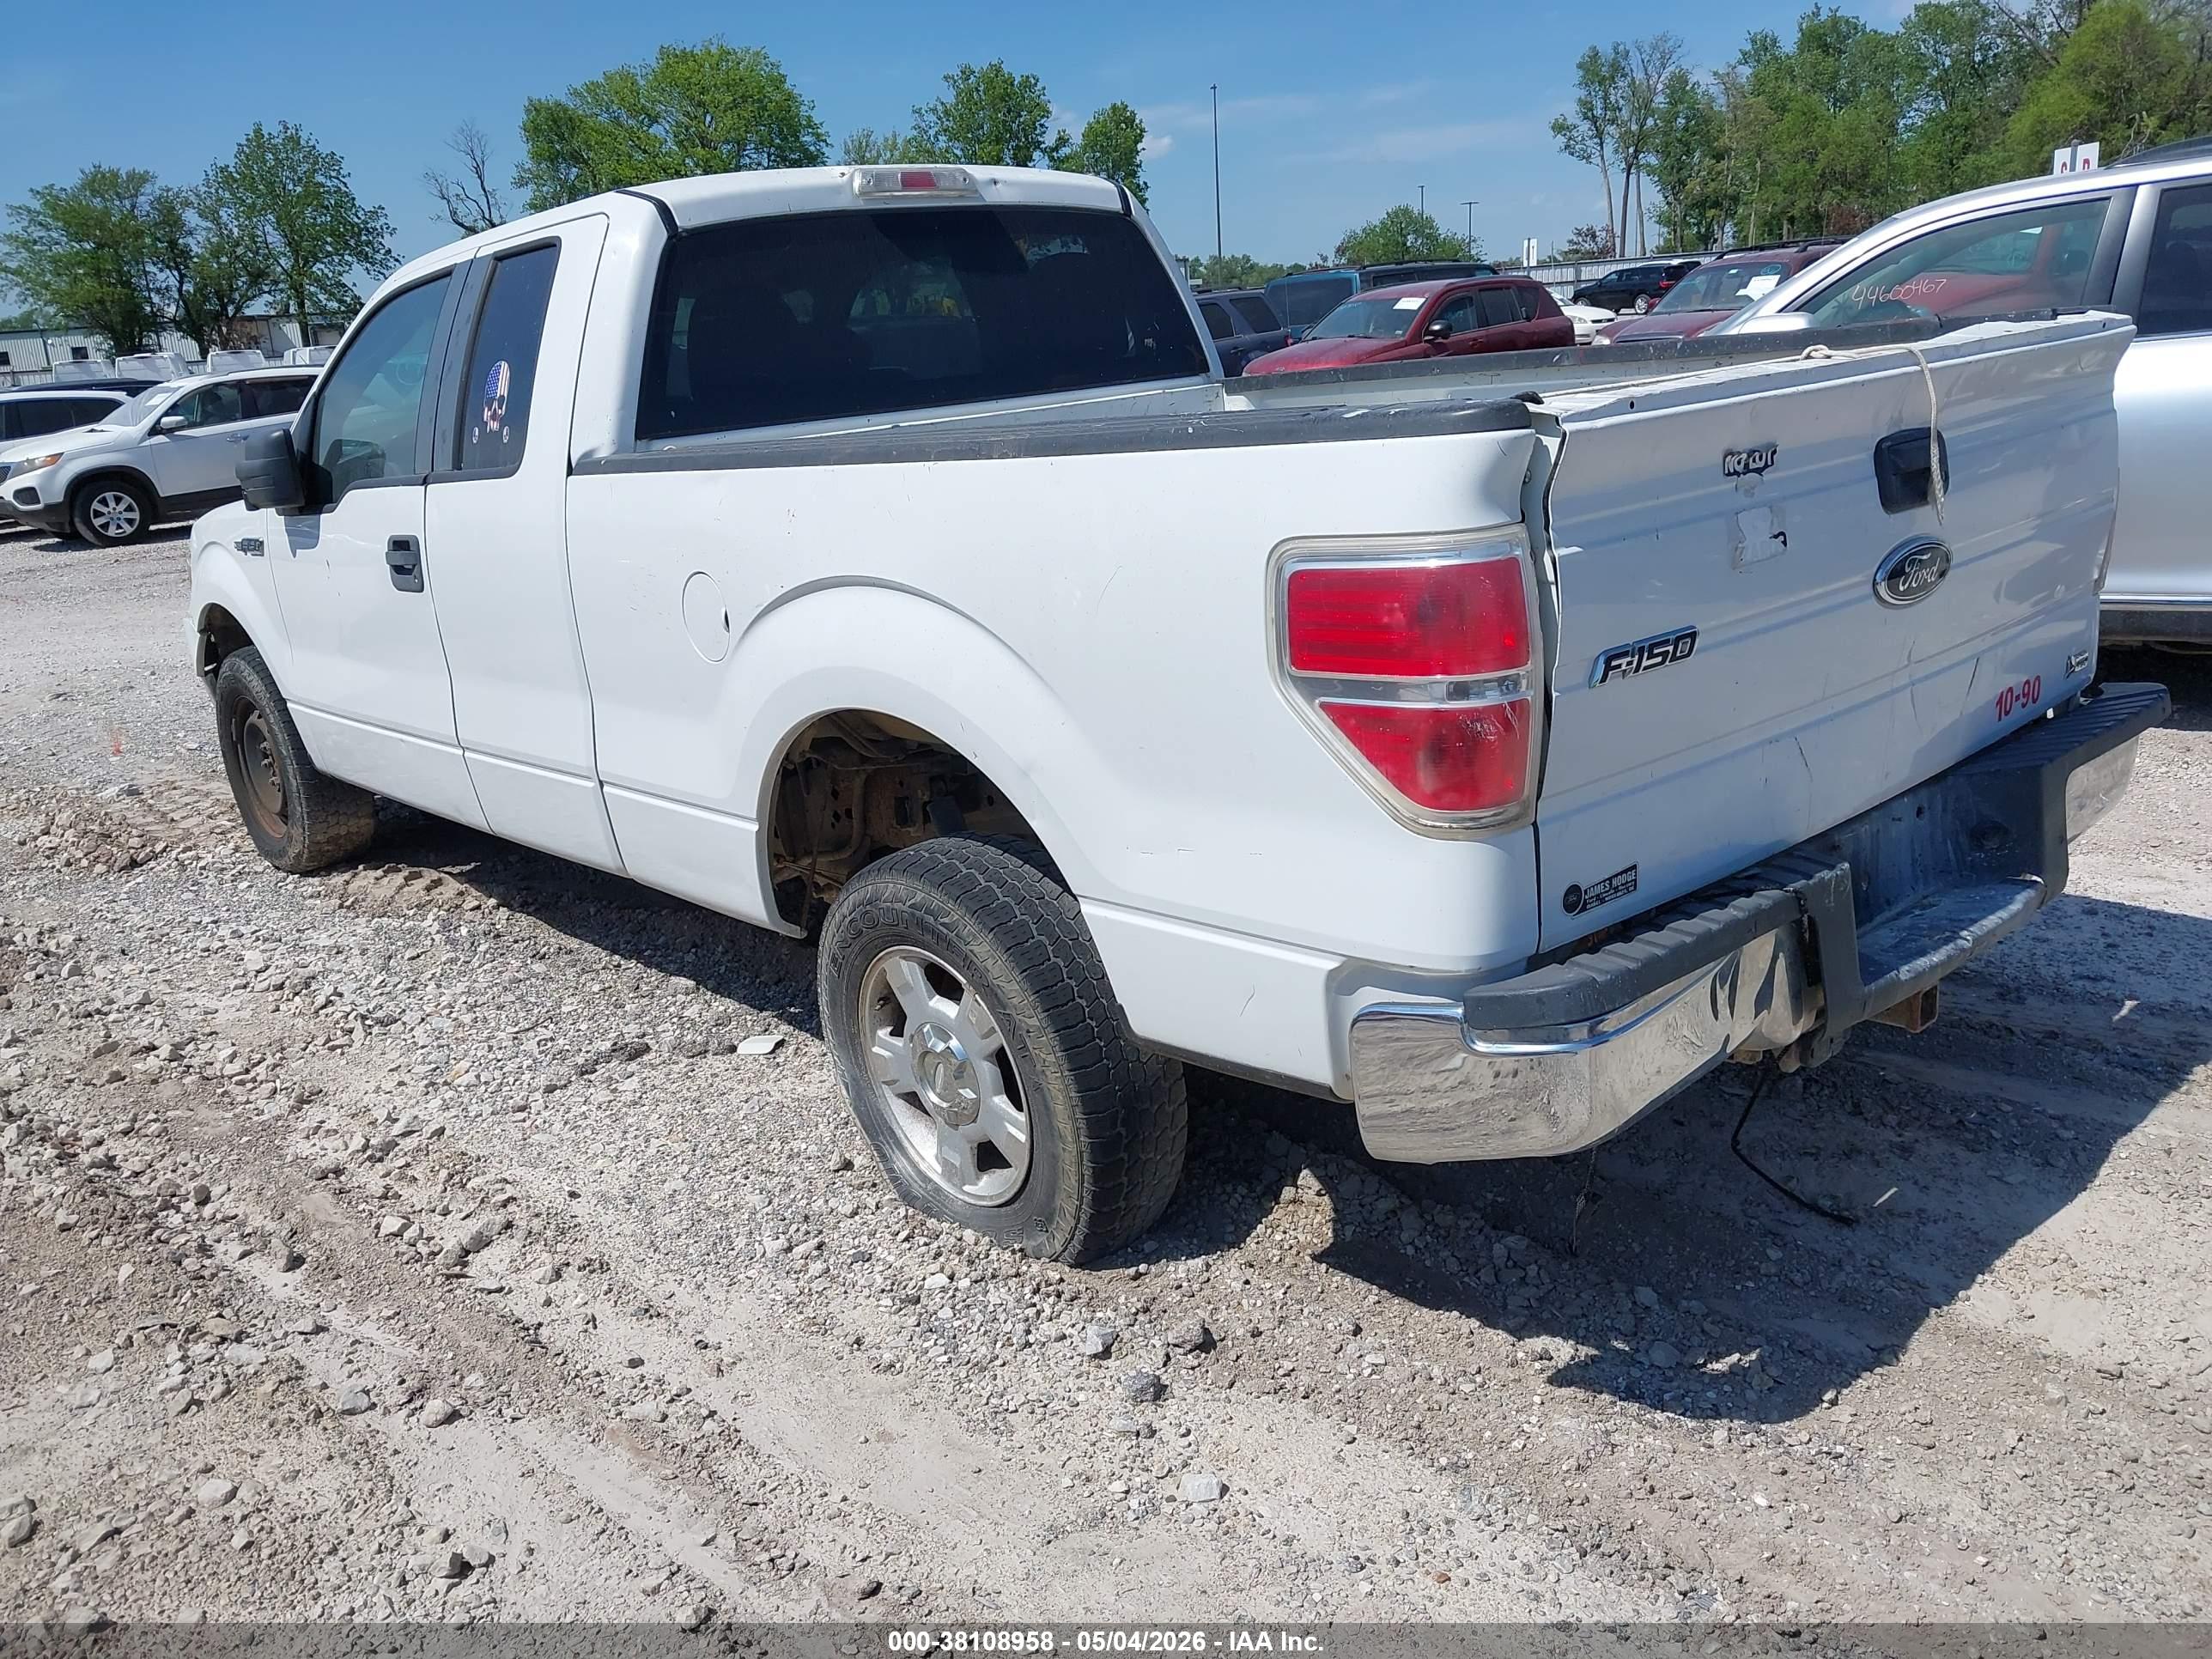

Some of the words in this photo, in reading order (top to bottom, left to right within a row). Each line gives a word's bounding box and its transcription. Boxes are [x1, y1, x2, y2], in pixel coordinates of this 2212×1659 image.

[1851, 278, 1947, 310] 44600467
[1899, 552, 1941, 592] Ford
[1593, 628, 1698, 687] F-150
[1995, 675, 2041, 722] 10-90
[1584, 880, 1610, 900] JAMES
[1612, 869, 1637, 889] HODGE
[830, 907, 989, 988] ENCOUNTER
